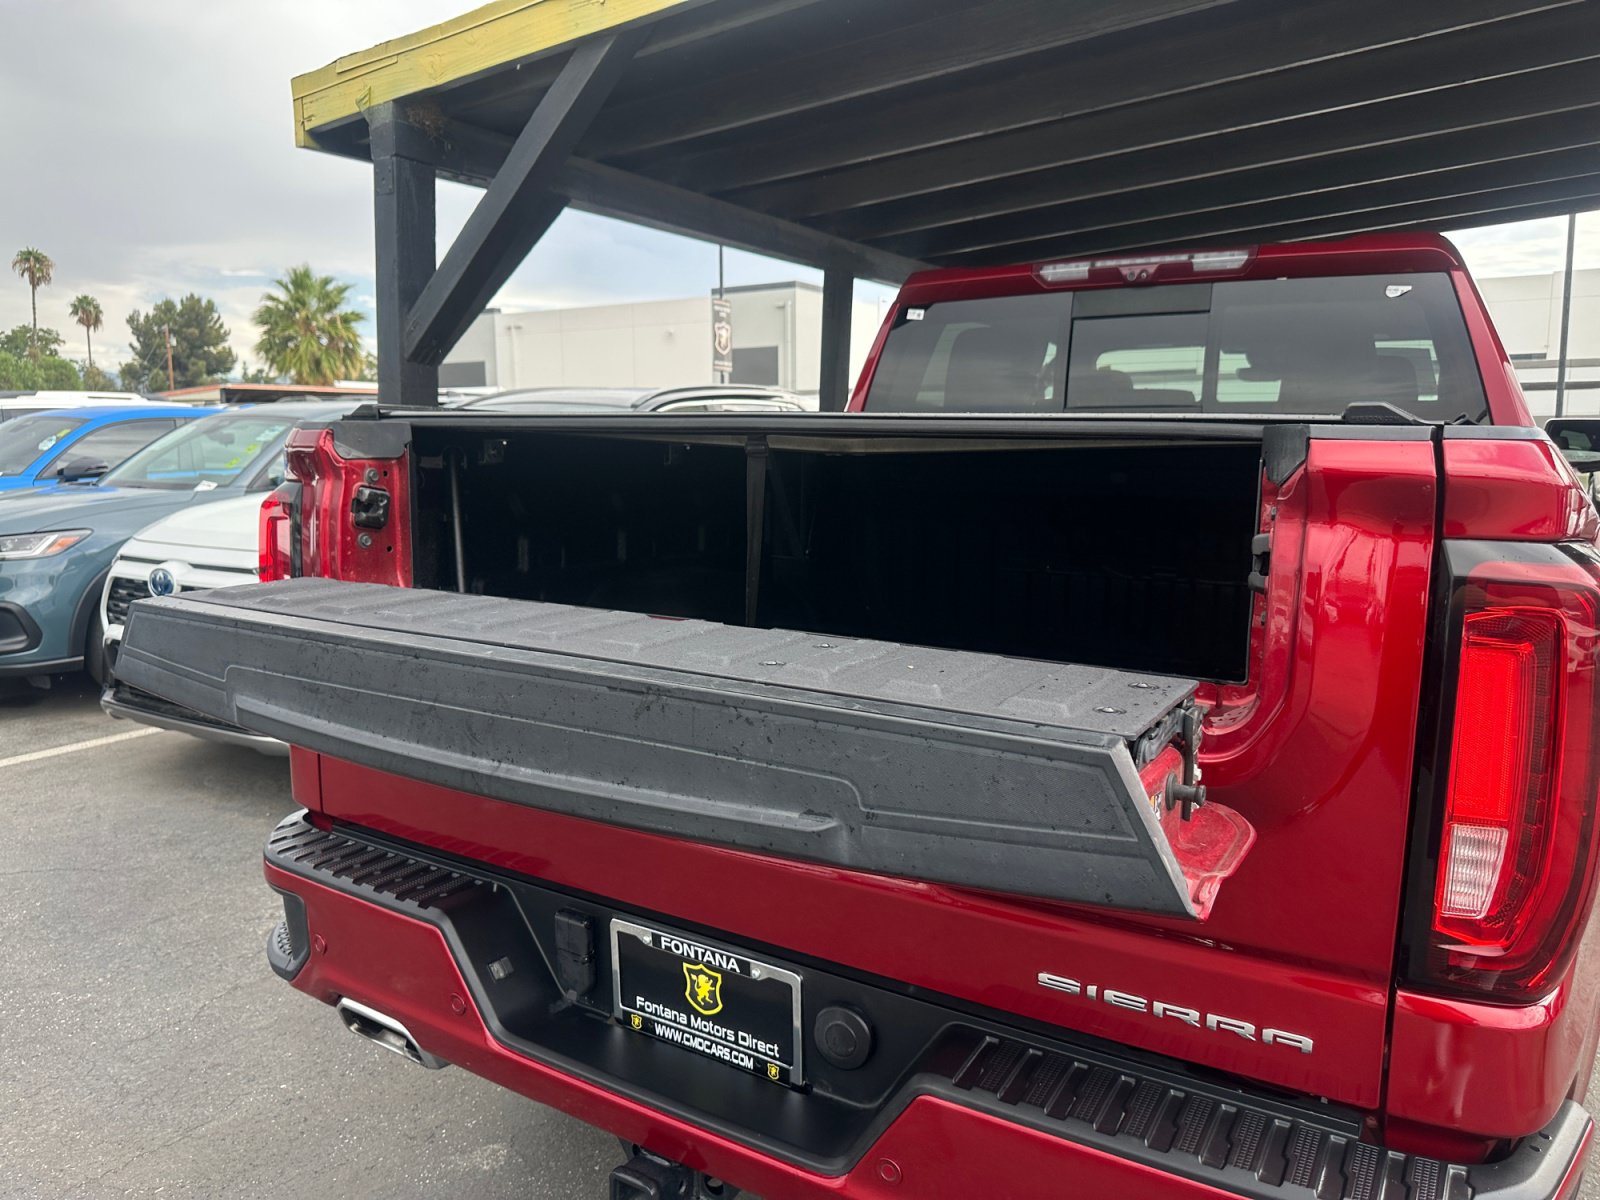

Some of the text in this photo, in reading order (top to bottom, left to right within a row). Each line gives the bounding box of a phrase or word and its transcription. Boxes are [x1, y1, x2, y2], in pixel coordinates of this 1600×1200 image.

[661, 936, 740, 973] FONTANA
[636, 996, 780, 1058] Fontana Motors Direct
[1037, 971, 1314, 1054] SIERRA
[654, 1022, 753, 1070] WWW.CMDCARS.COM
